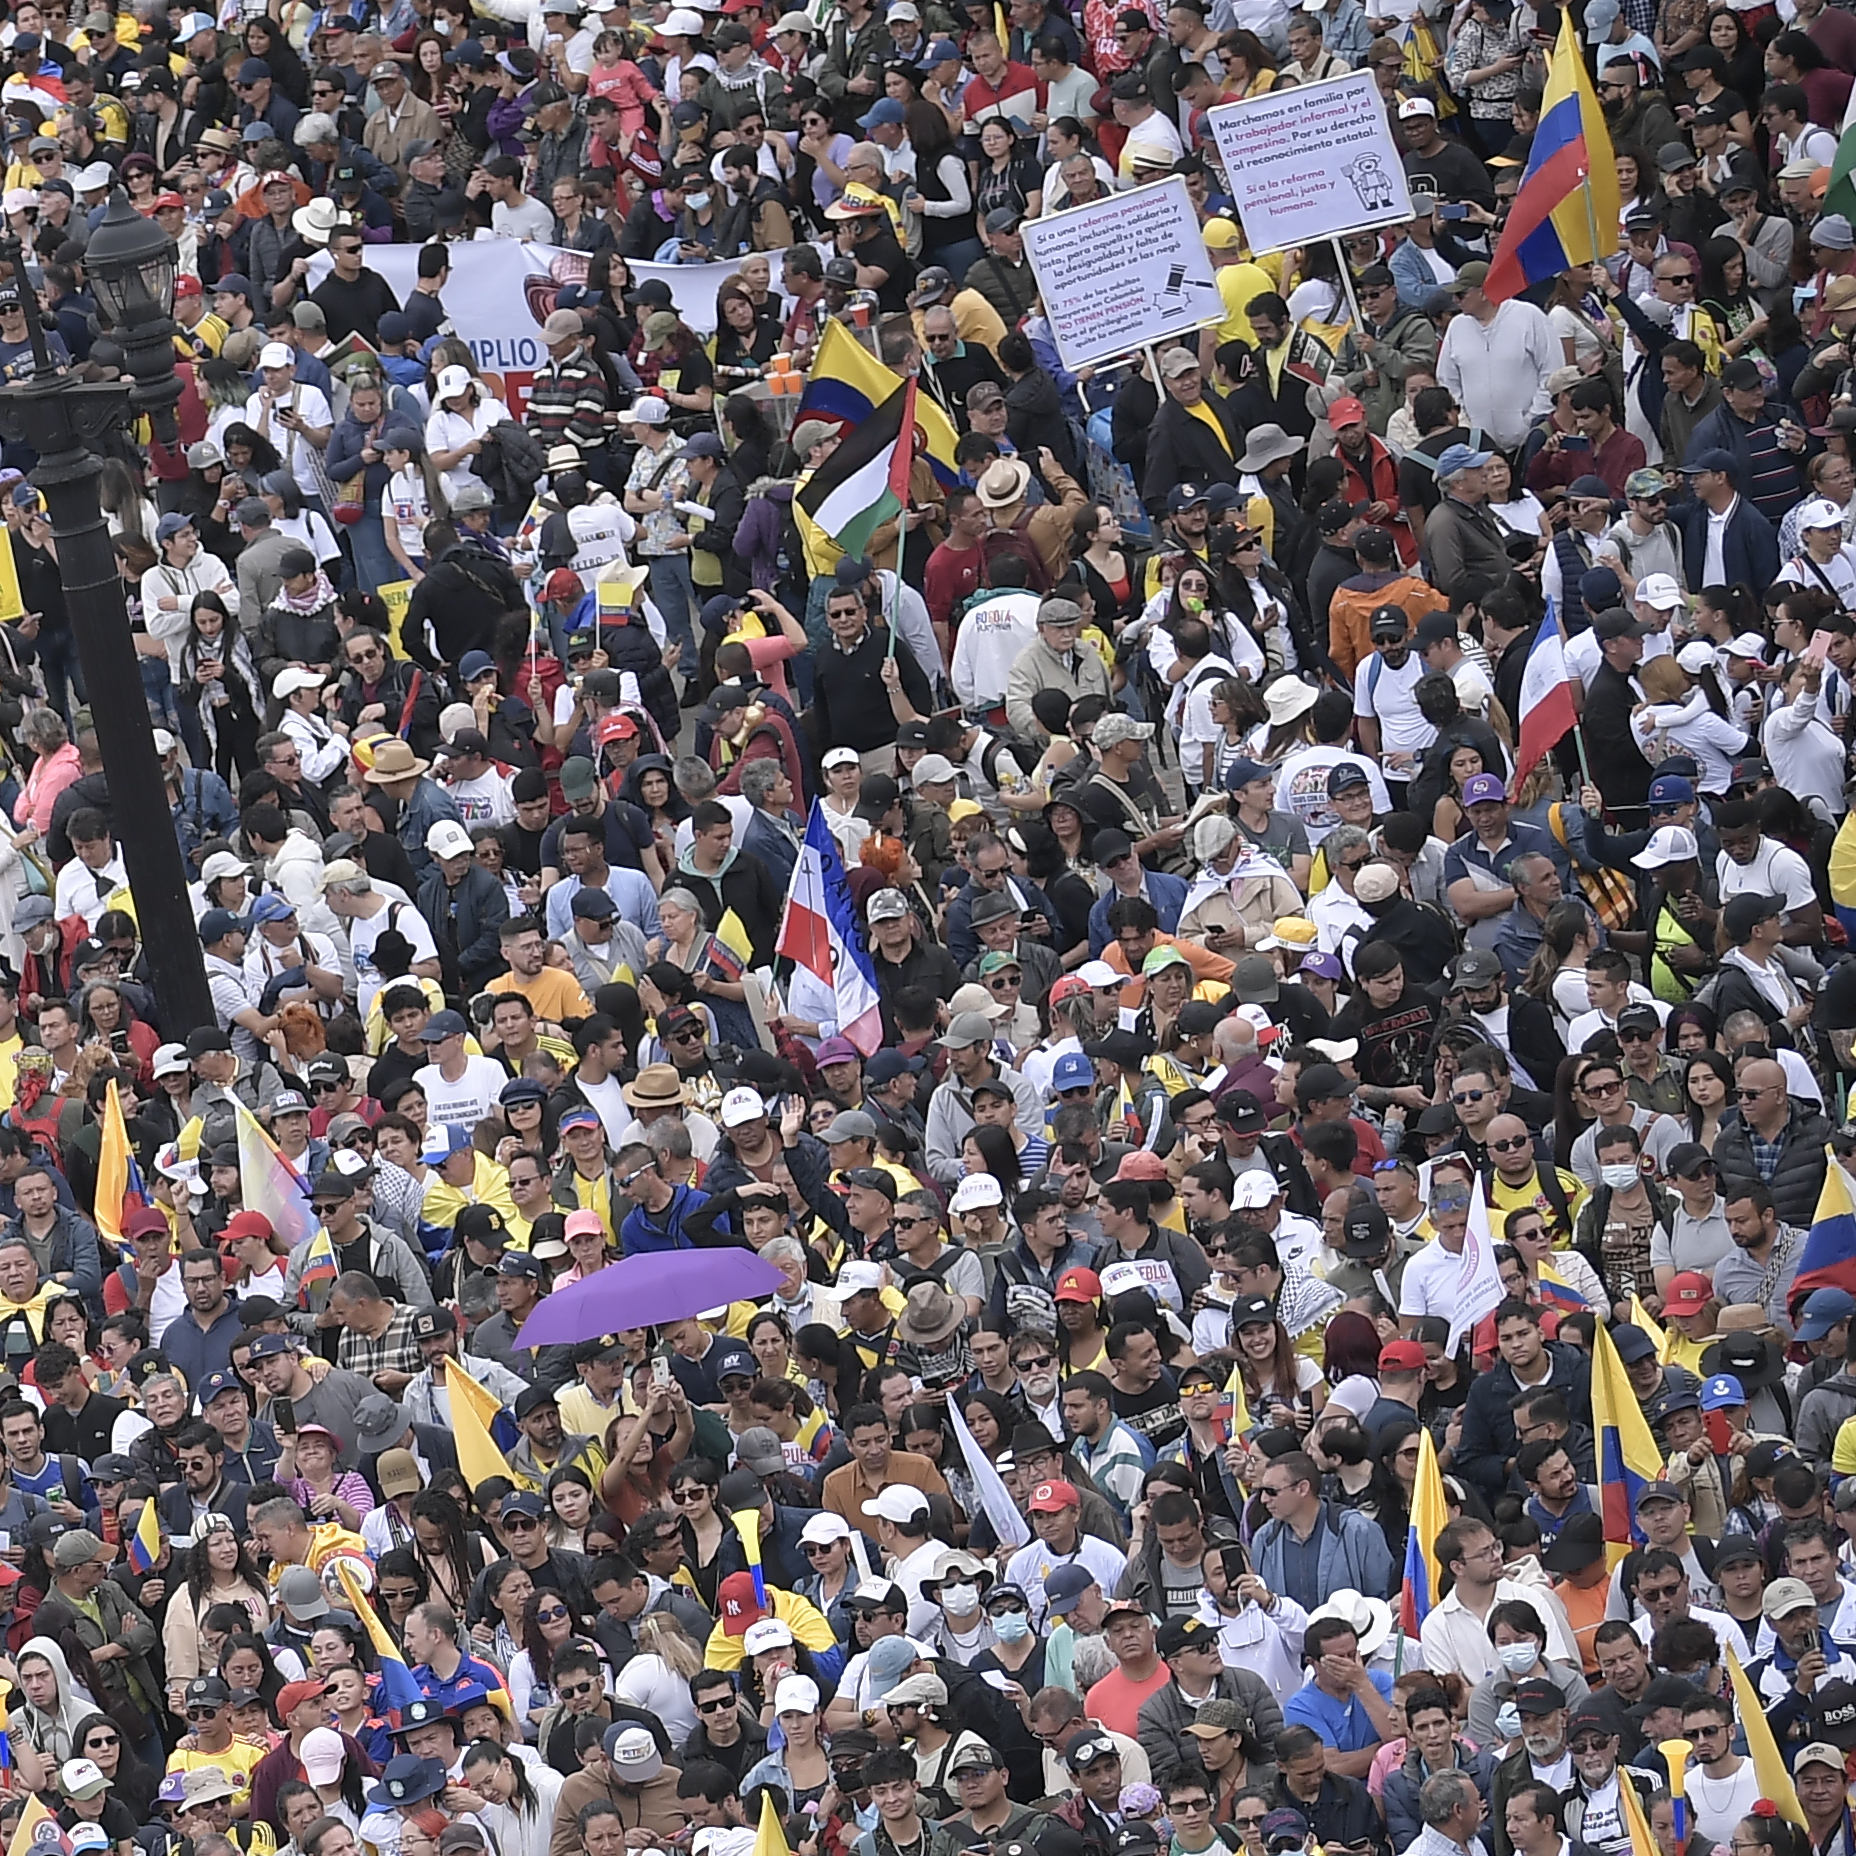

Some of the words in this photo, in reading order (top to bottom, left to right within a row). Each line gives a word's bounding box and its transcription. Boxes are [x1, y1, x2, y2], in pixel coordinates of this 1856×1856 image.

[1218, 107, 1285, 131] Marchamos
[1287, 103, 1301, 113] en
[1303, 91, 1343, 109] familia
[1346, 86, 1367, 99] por
[1223, 134, 1233, 146] el
[1235, 118, 1297, 142] trabajador
[1299, 104, 1349, 125] informal
[1350, 103, 1358, 114] y
[1361, 97, 1371, 108] el
[1226, 136, 1290, 159] campesino.
[1291, 131, 1311, 142] Por
[1315, 127, 1328, 136] su
[1330, 113, 1376, 132] derecho
[1233, 160, 1244, 172] al
[1246, 139, 1332, 167] reconocimiento
[1335, 126, 1378, 145] estatal.
[1243, 188, 1298, 211] pensional,
[1300, 181, 1326, 197] justa
[1267, 180, 1278, 190] la
[1280, 168, 1325, 186] reforma
[1057, 226, 1077, 238] una
[1078, 212, 1118, 230] reforma
[1120, 193, 1168, 219] pensional
[1269, 199, 1317, 216] humana.
[1034, 240, 1077, 258] humana,
[1079, 224, 1125, 243] inclusiva,
[1127, 207, 1171, 229] solidaria
[1038, 255, 1065, 272] justa,
[1068, 248, 1091, 264] para
[1093, 235, 1134, 257] aquellxs
[1145, 216, 1182, 239] quienes
[1053, 266, 1063, 278] la
[1066, 245, 1126, 275] desigualdad
[1135, 234, 1163, 250] falta
[1054, 261, 1125, 291] oportunidades
[1138, 249, 1155, 263] las
[1157, 240, 1182, 259] negó
[1054, 306, 1089, 322] mayores
[1104, 286, 1145, 305] Colombia
[1095, 286, 1108, 297] los
[1108, 276, 1141, 292] adultos
[1058, 321, 1072, 330] NO
[1074, 309, 1106, 326] TIENEN
[1060, 330, 1077, 342] Que
[1089, 312, 1128, 334] privilegio
[1075, 335, 1094, 349] quite
[1823, 1704, 1855, 1722] BOSS
